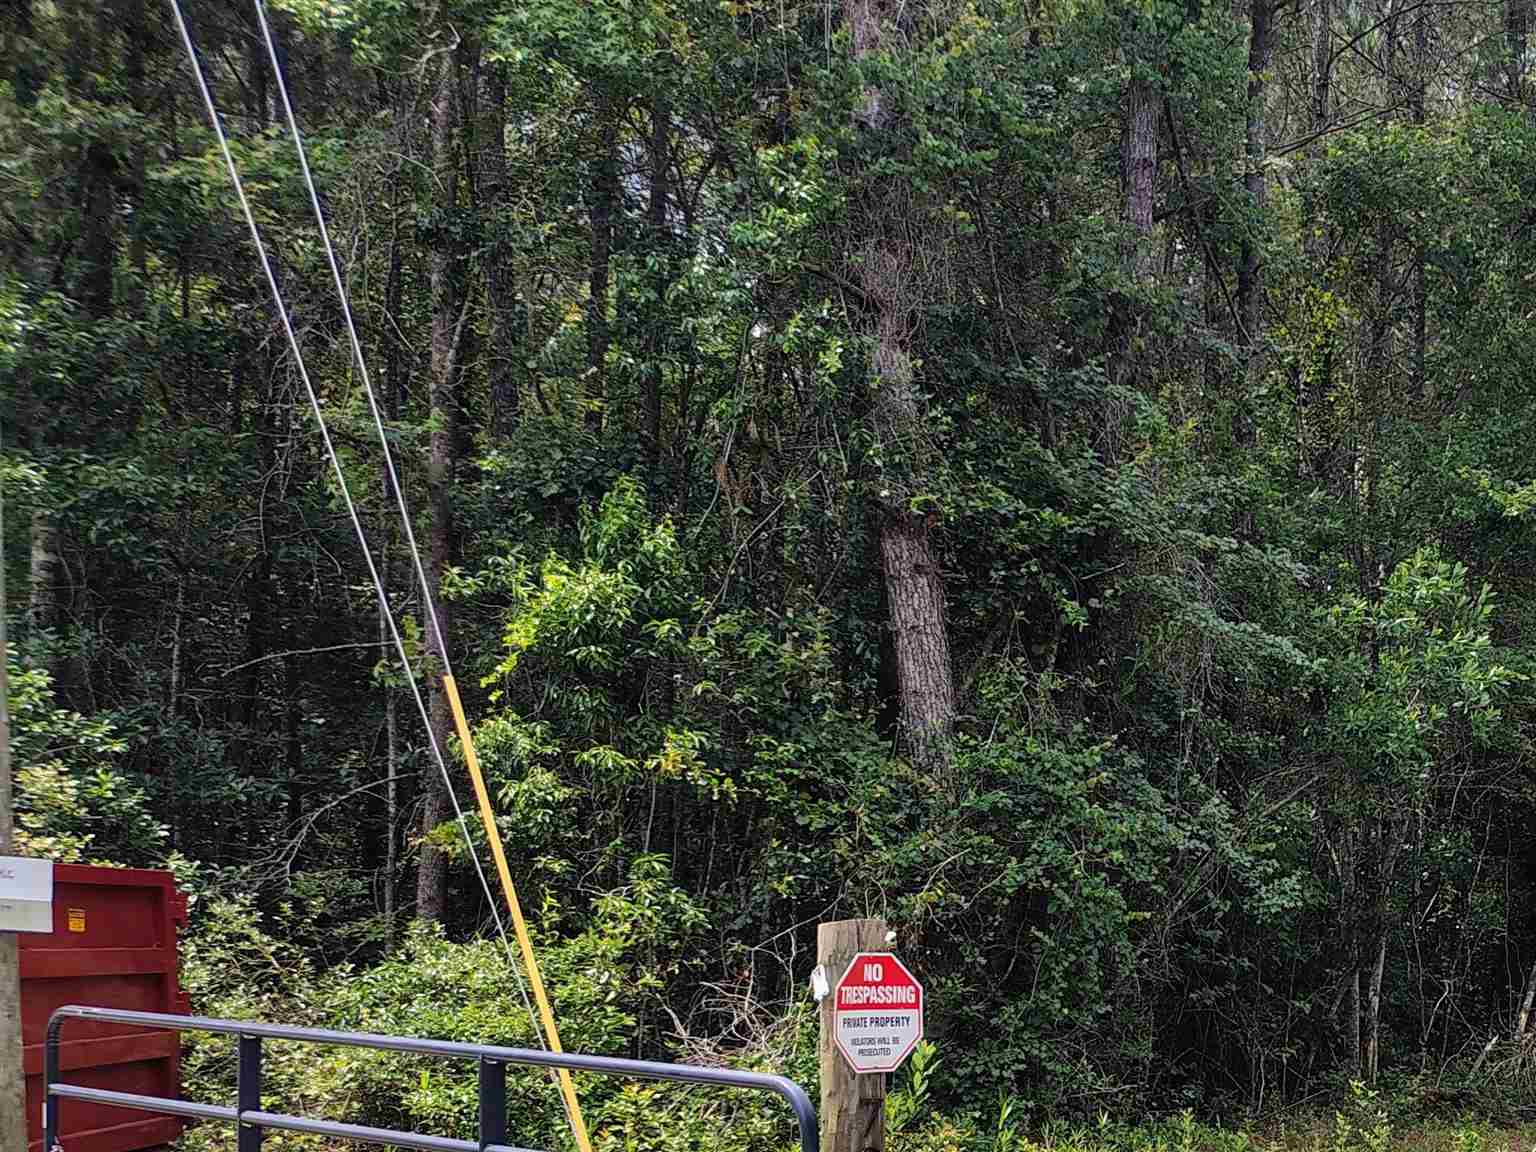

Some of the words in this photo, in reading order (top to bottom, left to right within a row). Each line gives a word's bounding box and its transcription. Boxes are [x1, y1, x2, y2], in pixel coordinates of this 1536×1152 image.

[863, 963, 883, 982] NO
[841, 985, 916, 1004] TRESPASSING
[842, 1016, 868, 1028] PRIVATE
[869, 1015, 910, 1028] PROPERTY
